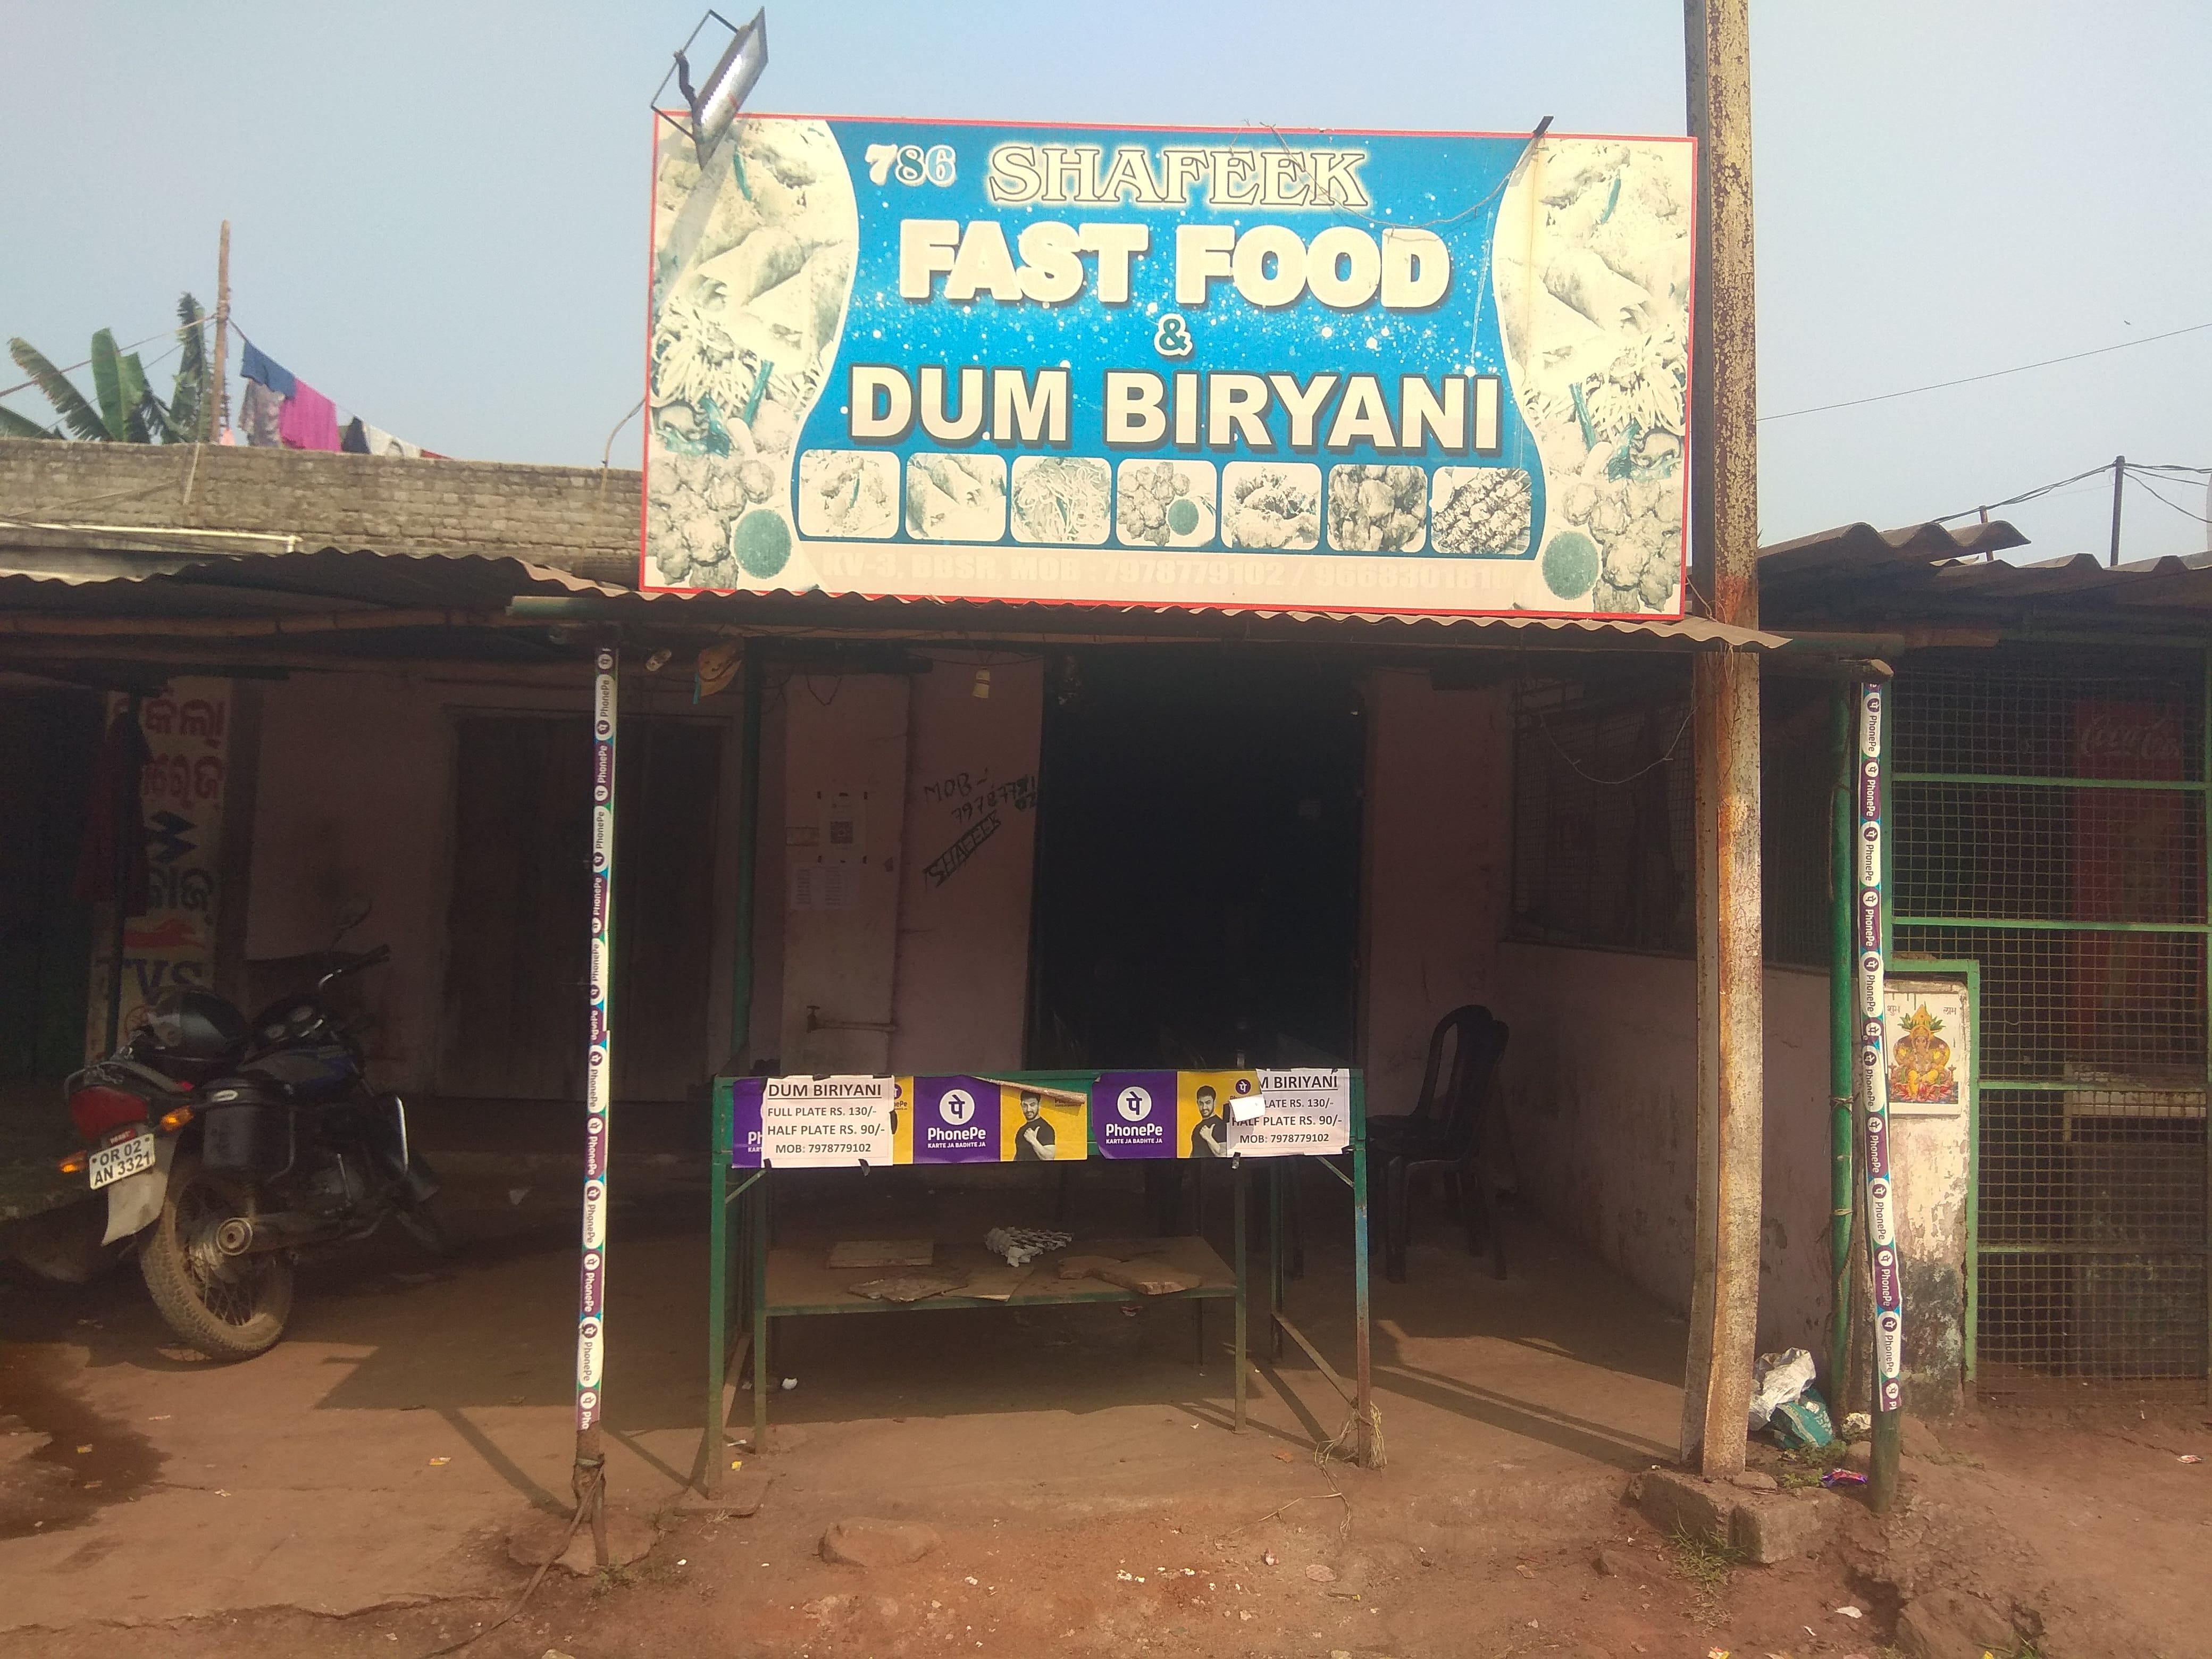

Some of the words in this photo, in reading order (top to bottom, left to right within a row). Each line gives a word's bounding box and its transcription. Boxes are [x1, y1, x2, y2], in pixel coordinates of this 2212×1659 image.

[865, 144, 956, 187] 786
[990, 146, 1368, 207] SHAFEEK
[899, 218, 1150, 304] FAST
[1175, 223, 1451, 309] FOOD
[1154, 313, 1193, 358] &
[850, 366, 1069, 444] DUM
[1105, 370, 1503, 452] BIRYANI
[1102, 558, 1284, 585] 7978779102
[600, 680, 609, 717] PhonePe
[1869, 715, 1877, 751] PhonePe
[597, 745, 608, 783] PhonePe
[1866, 780, 1875, 817] PhonePe
[596, 811, 604, 849] PhonePe
[1865, 844, 1874, 881] PhonePe
[1865, 909, 1875, 946] PhonePe
[1866, 975, 1875, 1012] PhonePe
[589, 1069, 598, 1107] PhonePe
[769, 1084, 808, 1096] DUM
[814, 1084, 881, 1096] BIRIYANI
[1274, 1076, 1337, 1088] BIRIYANI
[1865, 1069, 1875, 1107] PhonePe
[768, 1108, 792, 1116] FULL
[795, 1108, 827, 1116] PLATE
[830, 1107, 845, 1116] RS.
[849, 1106, 876, 1117] 130/-
[1263, 1116, 1296, 1126] PLATE
[1300, 1116, 1316, 1125] RS.
[1319, 1114, 1342, 1126] 90/-
[1265, 1099, 1287, 1108] LATE
[1290, 1099, 1304, 1108] RS.
[1308, 1097, 1334, 1109] 130/-
[768, 1126, 797, 1135] HALF
[801, 1125, 836, 1135] PLATE
[840, 1125, 857, 1134] RS.
[861, 1124, 885, 1136] 90/-
[776, 1144, 806, 1153] MOB:
[808, 1143, 871, 1153] 7978779102
[928, 1127, 986, 1141] PhonePe
[1106, 1123, 1163, 1136] PhonePe
[1240, 1135, 1268, 1143] MOB:
[1271, 1134, 1329, 1143] 7978779102
[94, 1165, 114, 1186] AN
[118, 1151, 150, 1175] 3321
[100, 1148, 120, 1166] OR
[124, 1140, 141, 1157] 02
[588, 1136, 598, 1175] PhonePe
[1870, 1135, 1881, 1173] PhonePe
[587, 1204, 596, 1243] PhonePe
[1875, 1202, 1886, 1240] PhonePe
[585, 1272, 595, 1312] PhonePe
[1881, 1269, 1892, 1306] PhonePe
[584, 1342, 592, 1381] PhonePe
[1886, 1335, 1894, 1372] PhonePe
